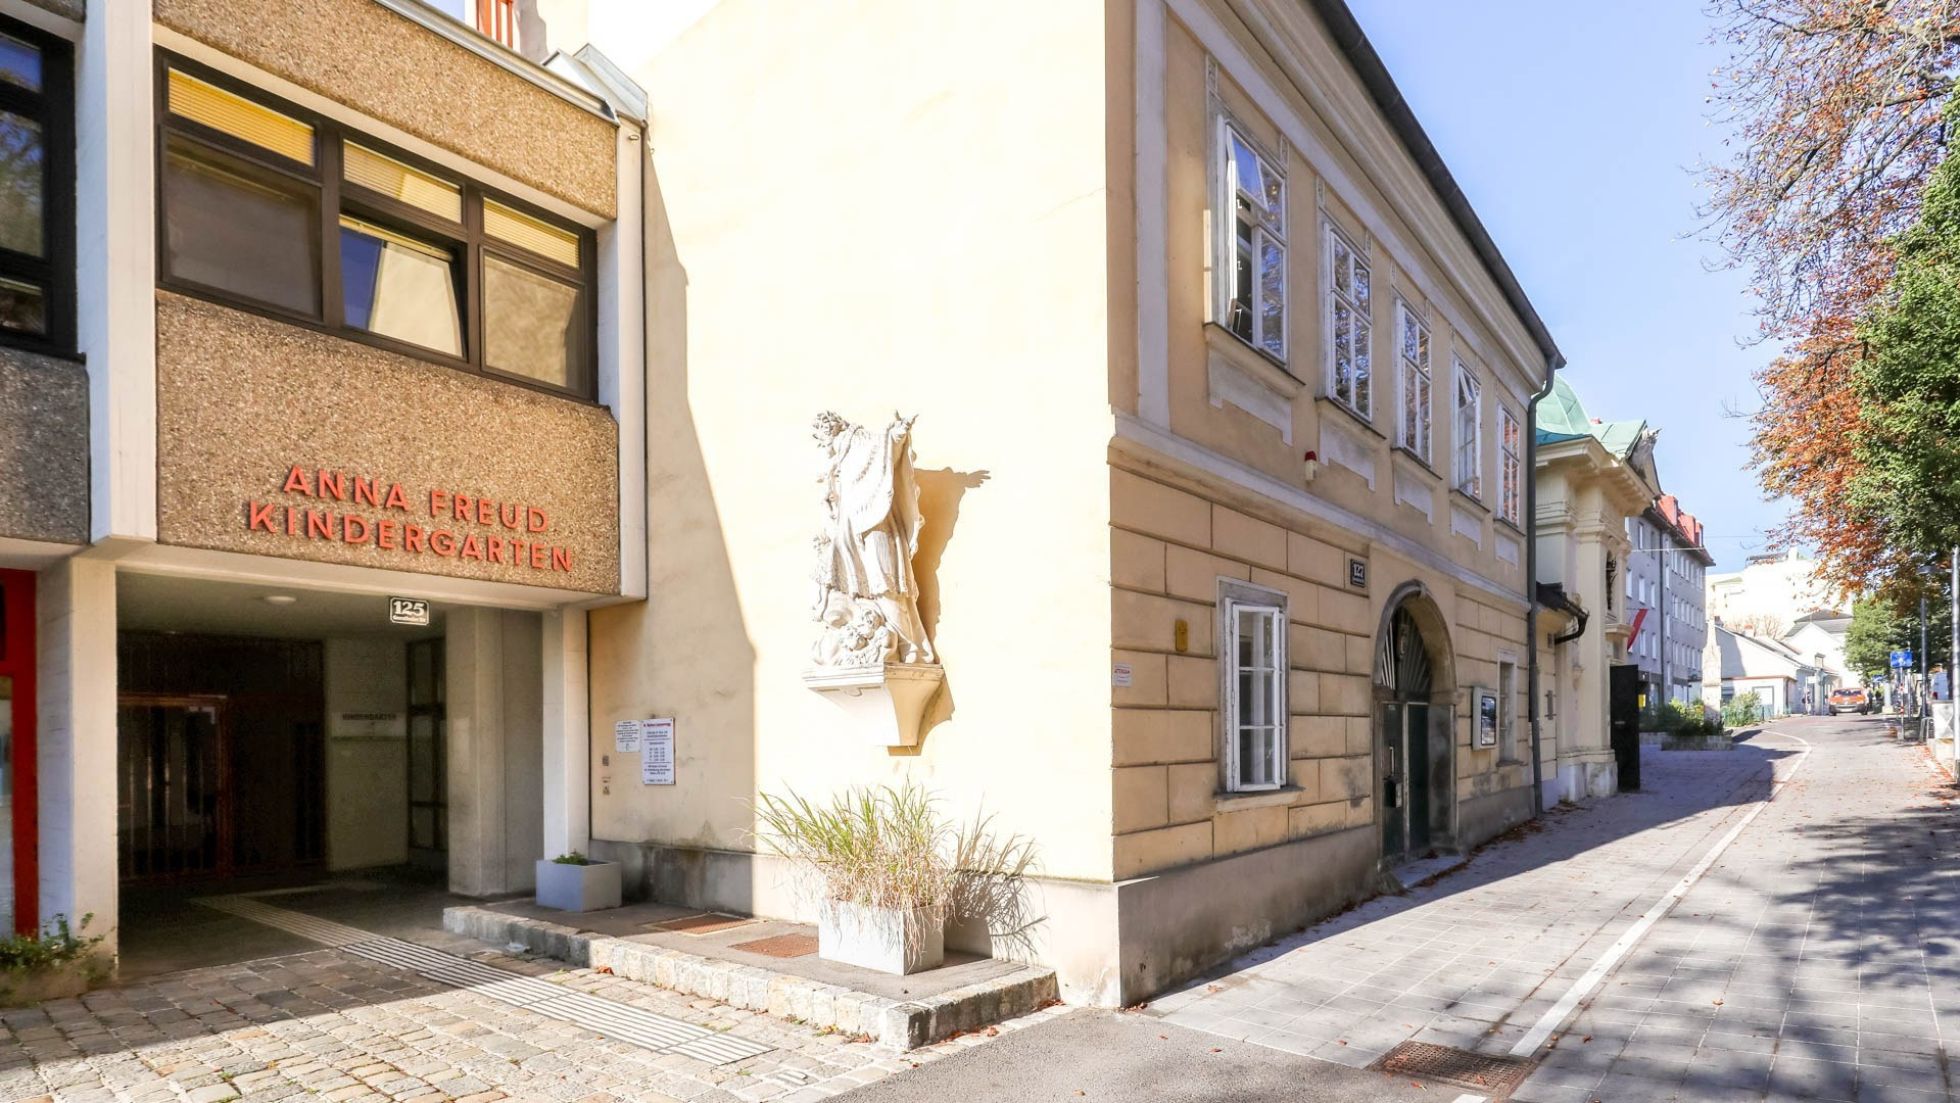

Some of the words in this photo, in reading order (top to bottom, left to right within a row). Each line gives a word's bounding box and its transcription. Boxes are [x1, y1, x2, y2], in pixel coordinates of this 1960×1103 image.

[284, 465, 409, 511] ANNA
[430, 489, 548, 533] FREUD
[249, 501, 573, 572] KINDERGARTEN
[393, 600, 425, 617] 125
